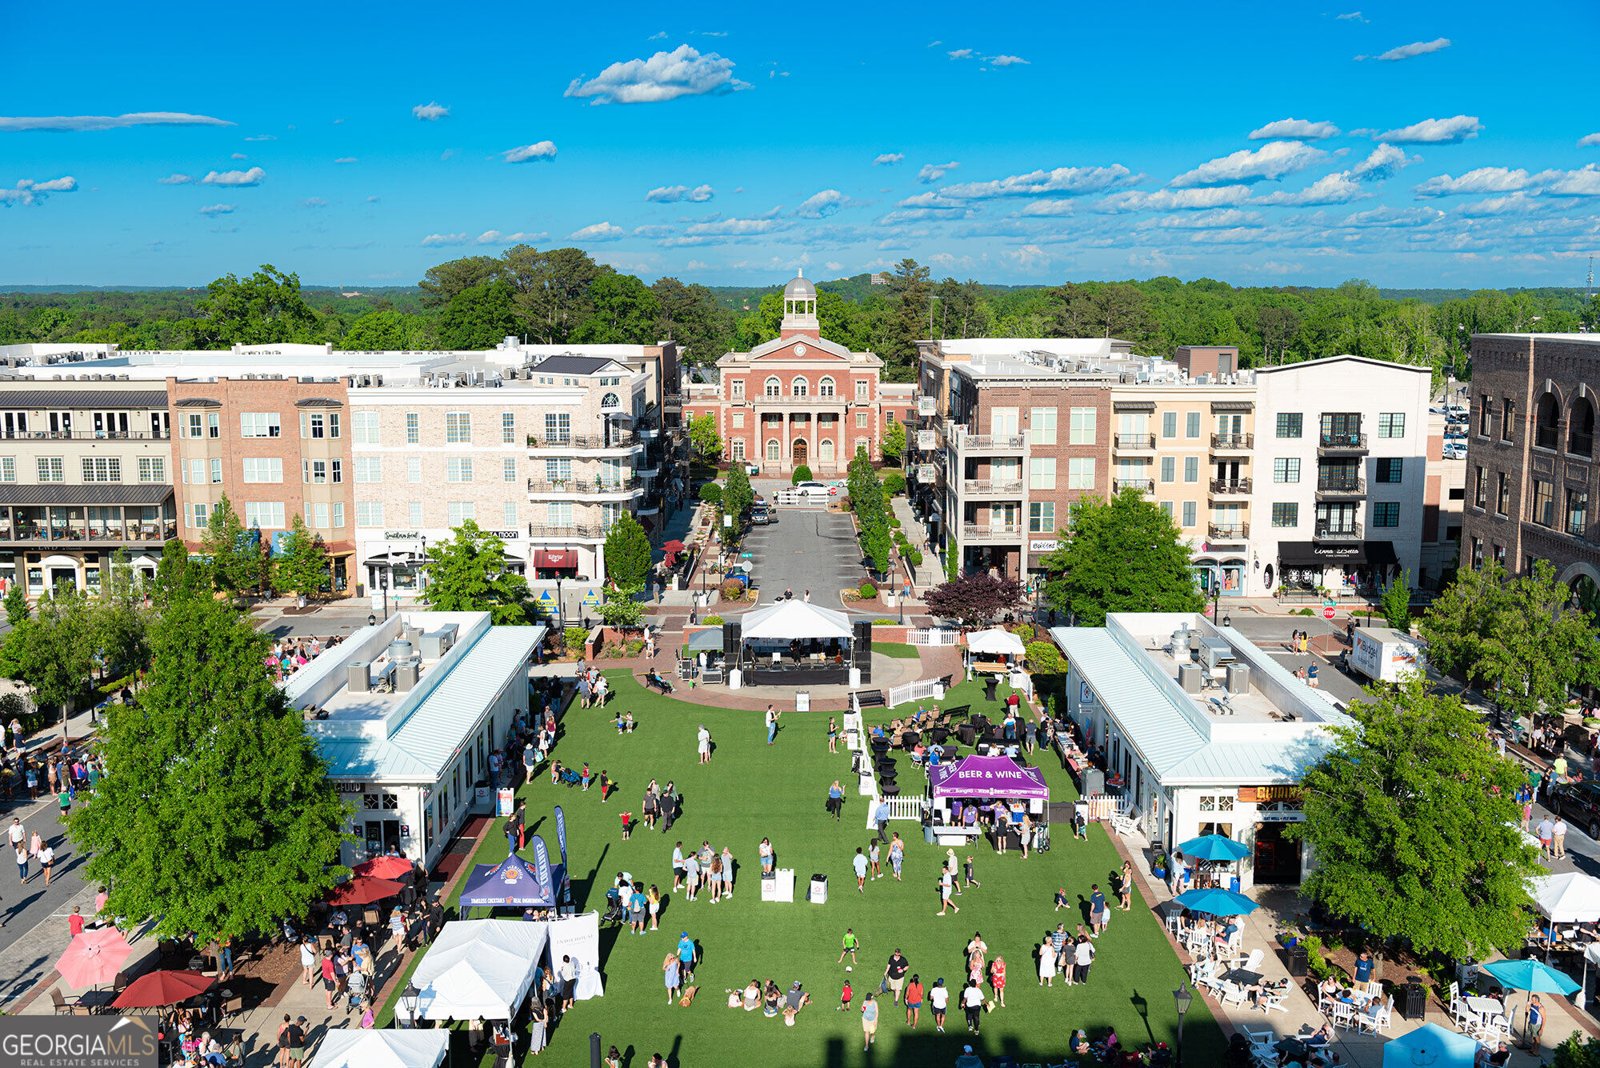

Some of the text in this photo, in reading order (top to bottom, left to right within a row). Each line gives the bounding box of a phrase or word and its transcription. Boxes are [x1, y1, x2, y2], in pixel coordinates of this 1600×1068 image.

[958, 770, 983, 779] BEER
[985, 771, 993, 779] &
[995, 771, 1022, 779] WINE
